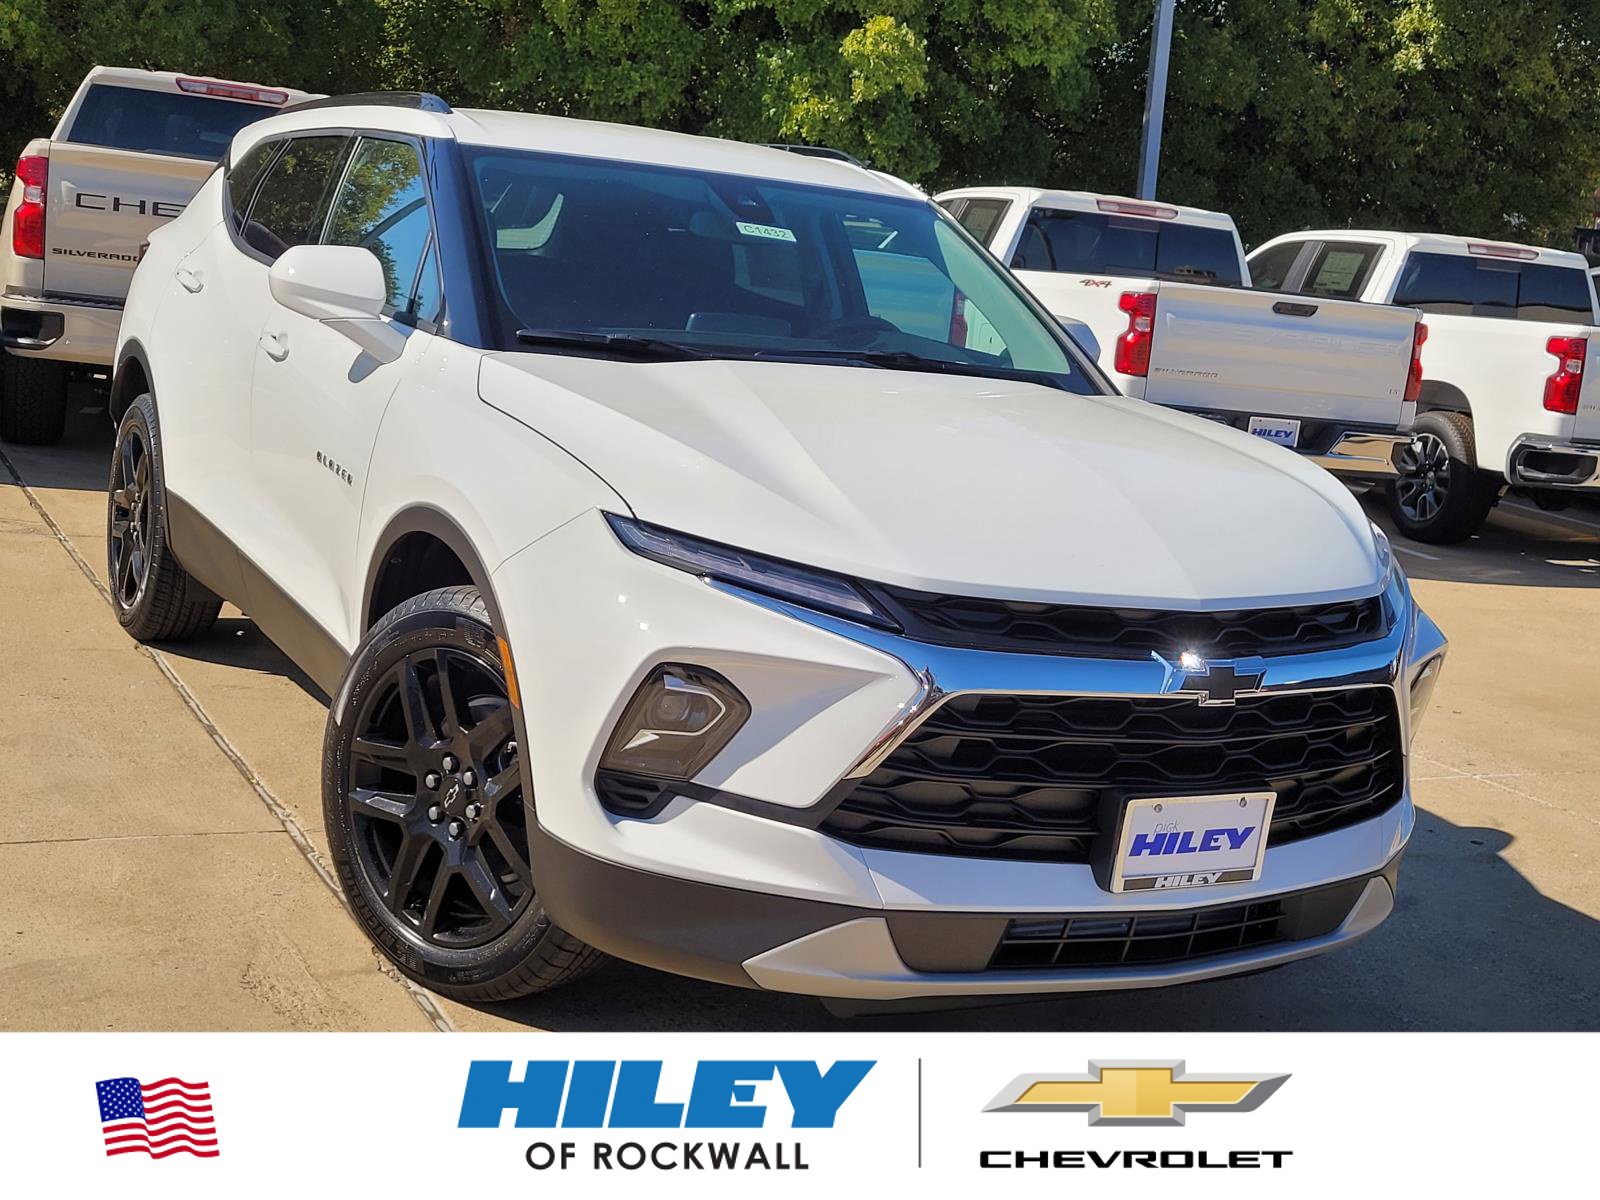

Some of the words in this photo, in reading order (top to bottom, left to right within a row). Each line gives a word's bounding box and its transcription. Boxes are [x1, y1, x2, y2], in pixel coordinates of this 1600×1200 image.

[743, 224, 788, 239] C1432
[1250, 427, 1294, 439] HILEY
[316, 450, 353, 487] BLAZER
[1129, 826, 1257, 857] HILEY
[1154, 871, 1223, 889] HILEY
